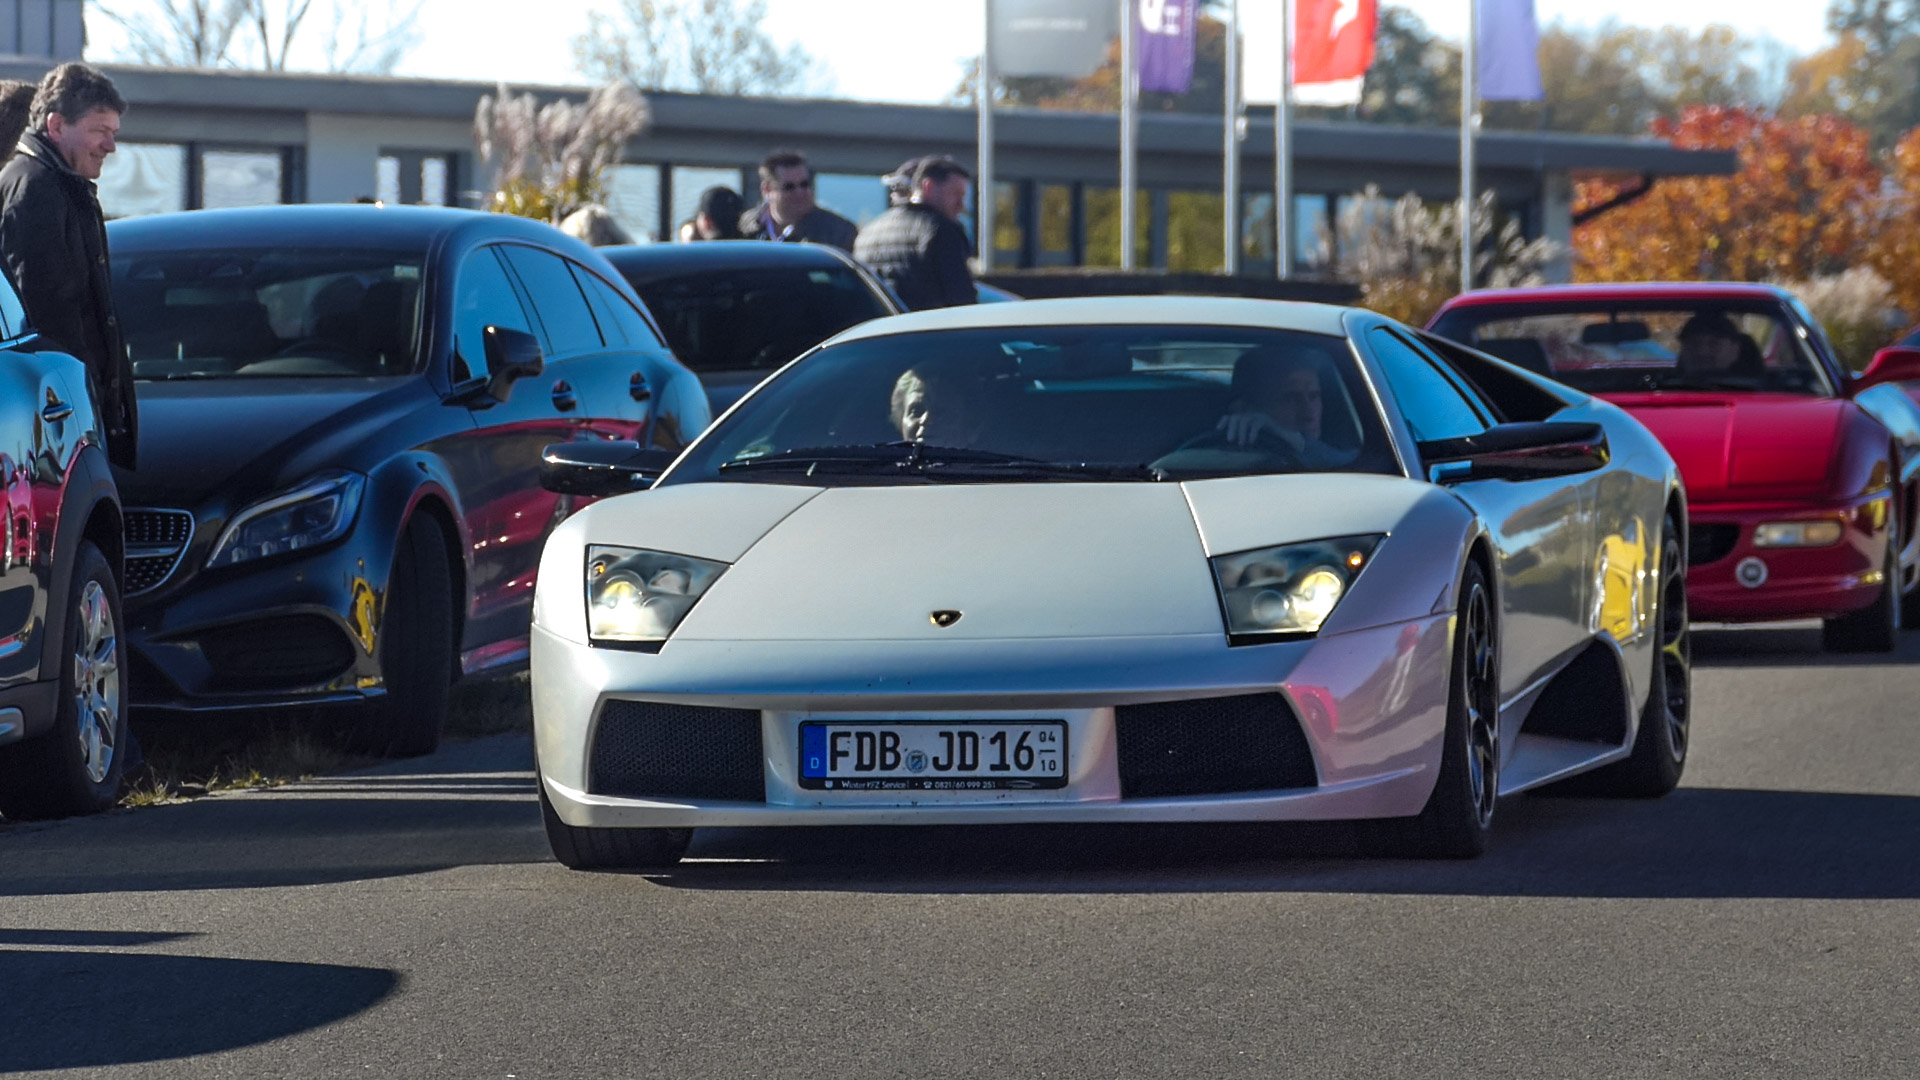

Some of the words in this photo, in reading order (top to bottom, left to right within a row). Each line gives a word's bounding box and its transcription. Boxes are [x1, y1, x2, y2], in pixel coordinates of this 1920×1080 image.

[1039, 731, 1056, 743] 04
[830, 731, 901, 772] FDB
[932, 731, 979, 772] JD
[989, 731, 1035, 772] 16
[810, 757, 820, 769] D
[1041, 760, 1057, 772] 10
